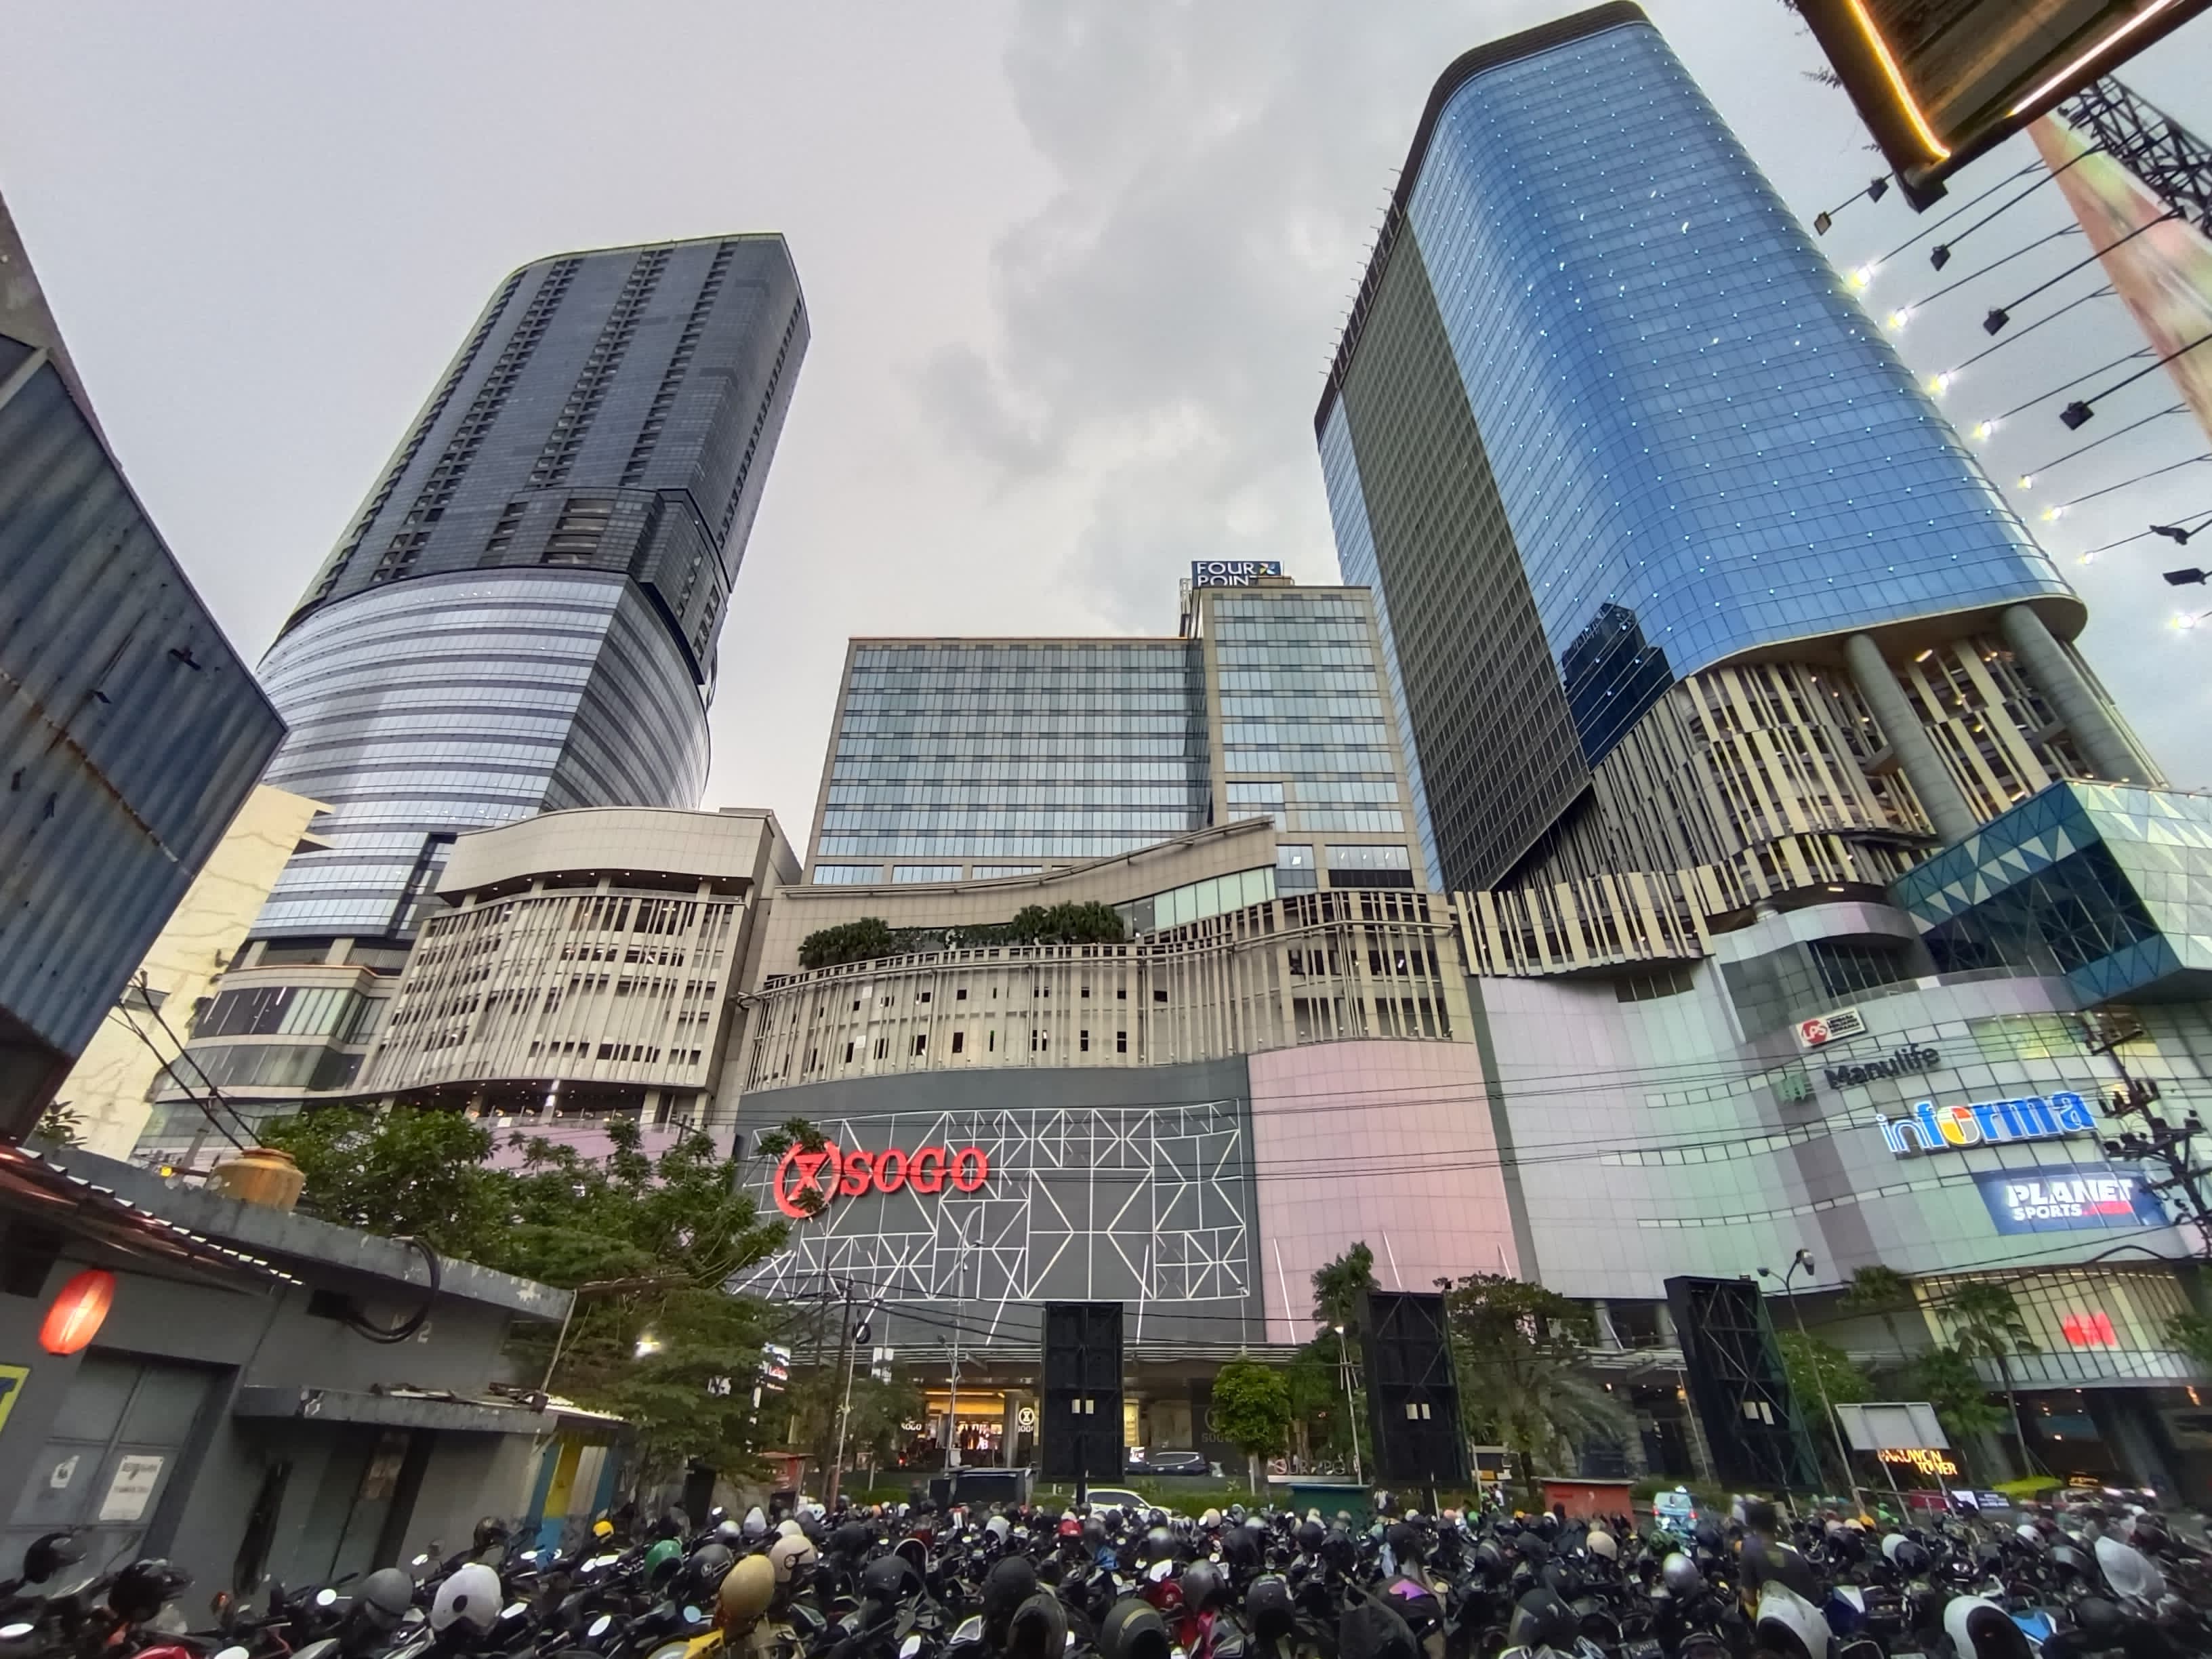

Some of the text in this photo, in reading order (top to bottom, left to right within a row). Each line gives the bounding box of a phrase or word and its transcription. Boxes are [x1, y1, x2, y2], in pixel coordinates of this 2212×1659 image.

[1197, 562, 1257, 575] FOUR
[1824, 1043, 1941, 1089] Manulife
[1875, 1090, 2097, 1153] informa
[840, 1147, 987, 1195] SOGO
[2006, 1179, 2133, 1208] PLANET
[2013, 1204, 2083, 1221] SPORTS
